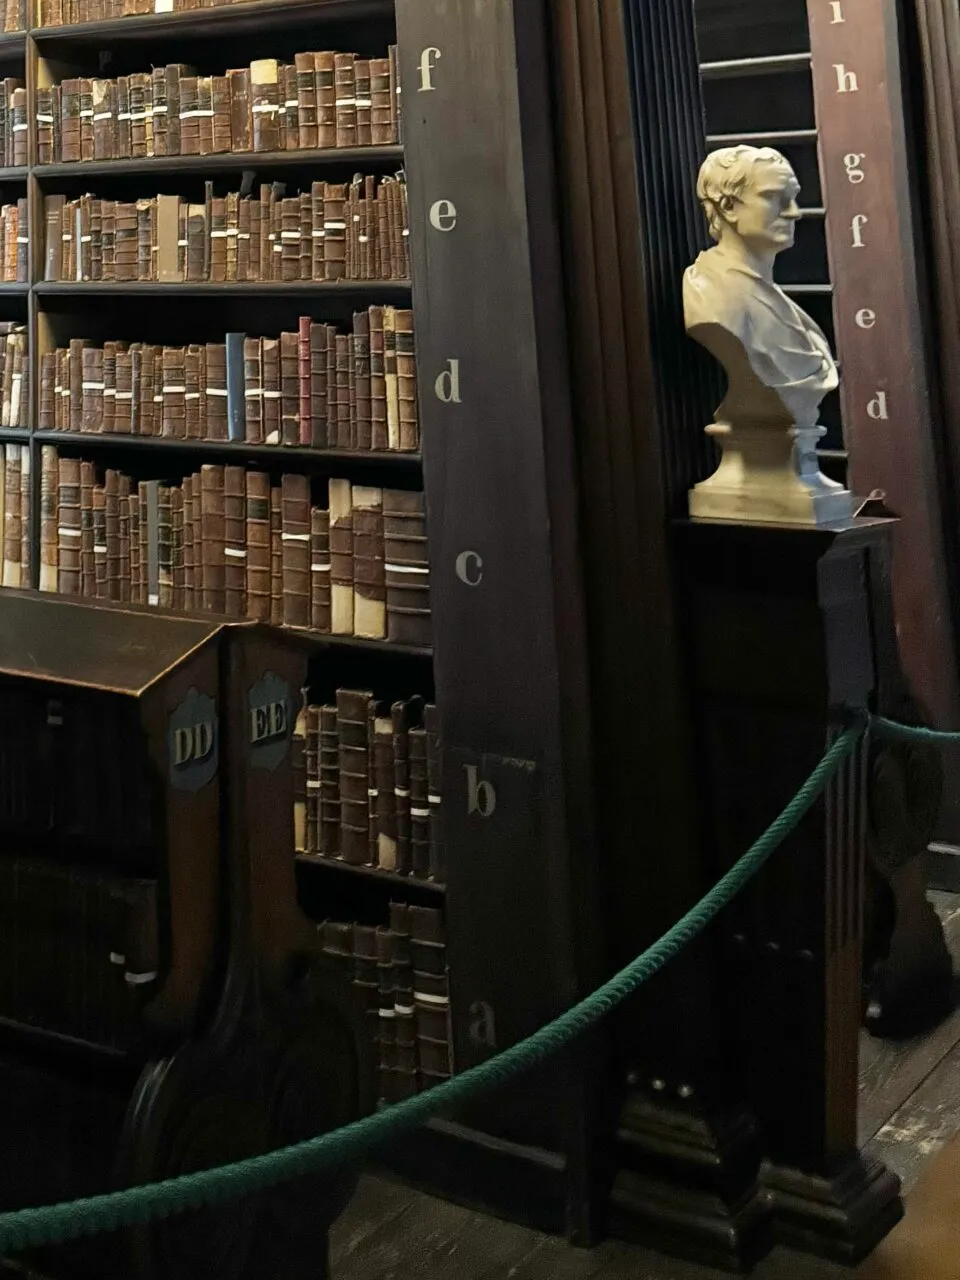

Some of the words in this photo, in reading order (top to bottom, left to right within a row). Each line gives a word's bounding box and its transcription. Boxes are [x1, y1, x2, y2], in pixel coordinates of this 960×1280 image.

[417, 48, 441, 91] f
[833, 64, 858, 92] h
[844, 154, 865, 183] g
[430, 200, 456, 231] e
[852, 215, 867, 247] f
[856, 309, 875, 328] e
[435, 359, 461, 402] d
[867, 392, 887, 419] d
[456, 551, 482, 585] c
[251, 699, 287, 744] EE
[174, 723, 213, 765] DD
[463, 765, 496, 816] b
